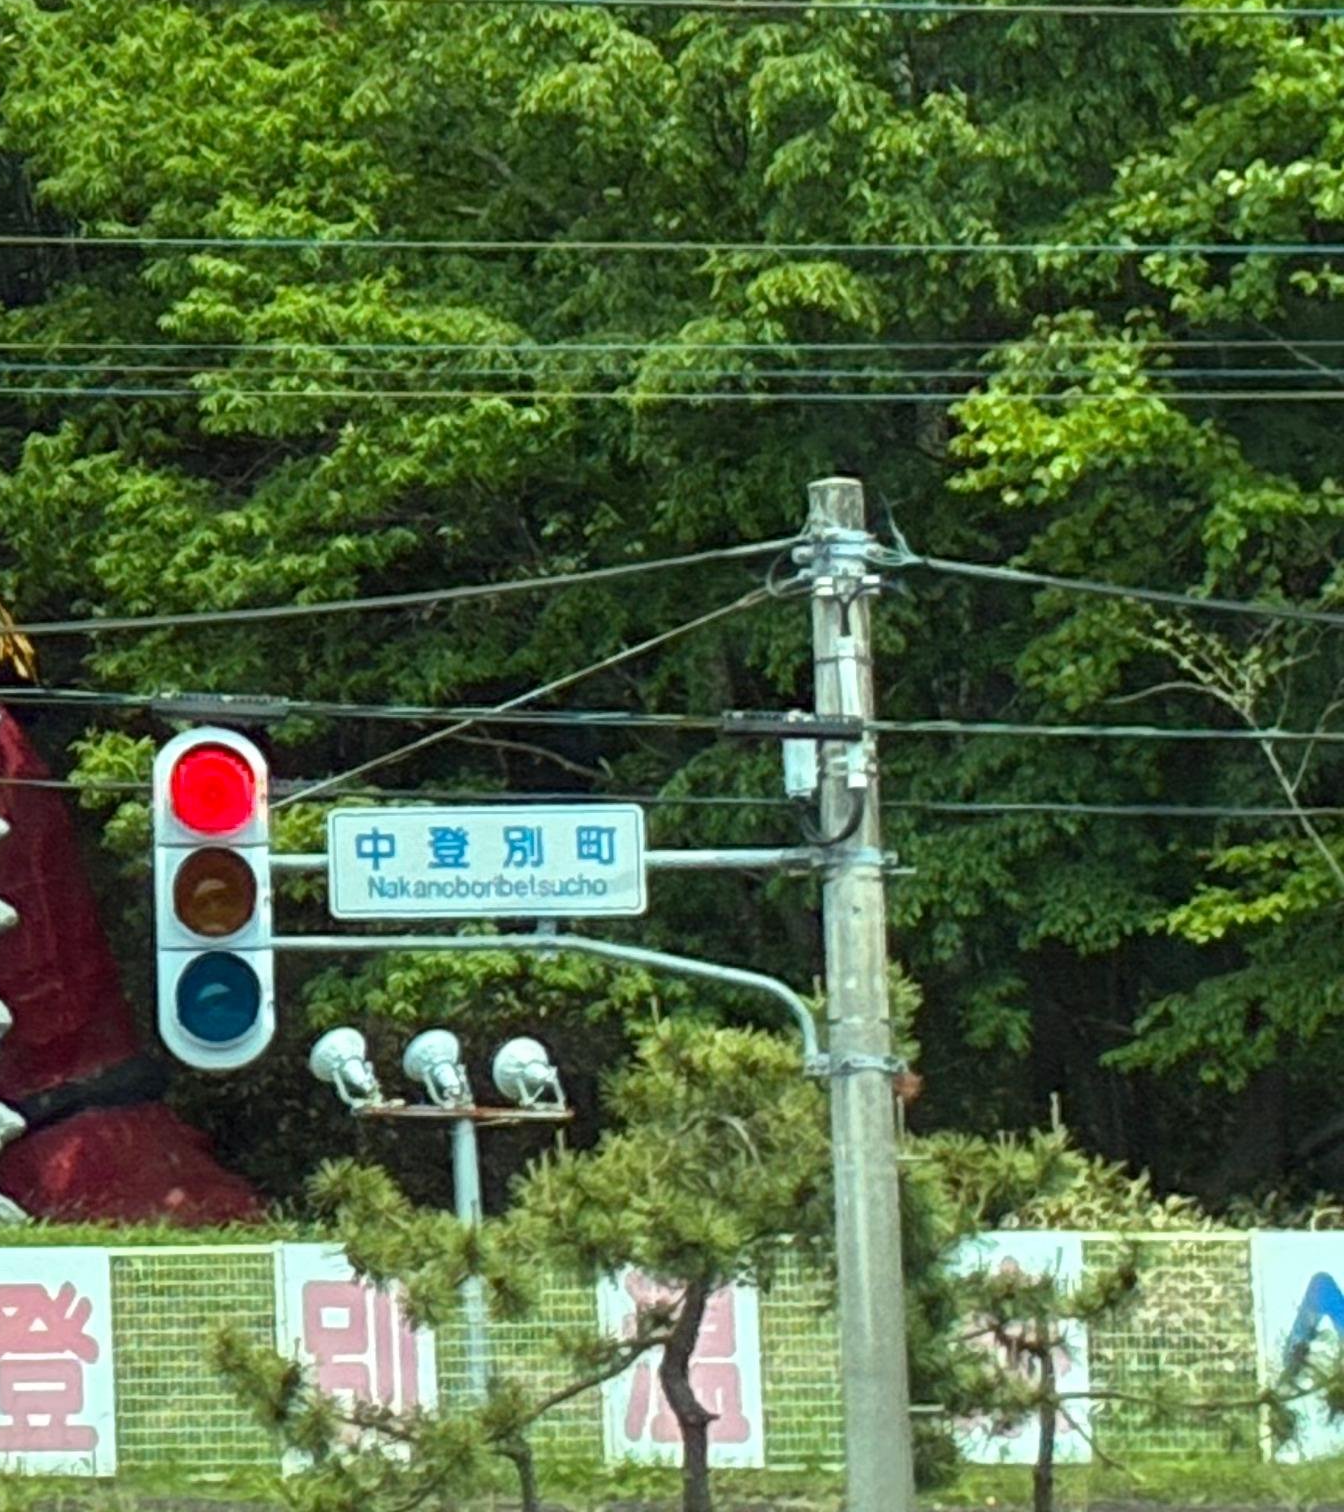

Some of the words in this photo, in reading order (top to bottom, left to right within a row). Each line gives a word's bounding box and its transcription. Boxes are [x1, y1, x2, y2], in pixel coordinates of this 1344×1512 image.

[354, 824, 617, 870] 中登別町
[367, 873, 608, 900] Nakanoboribetsucho
